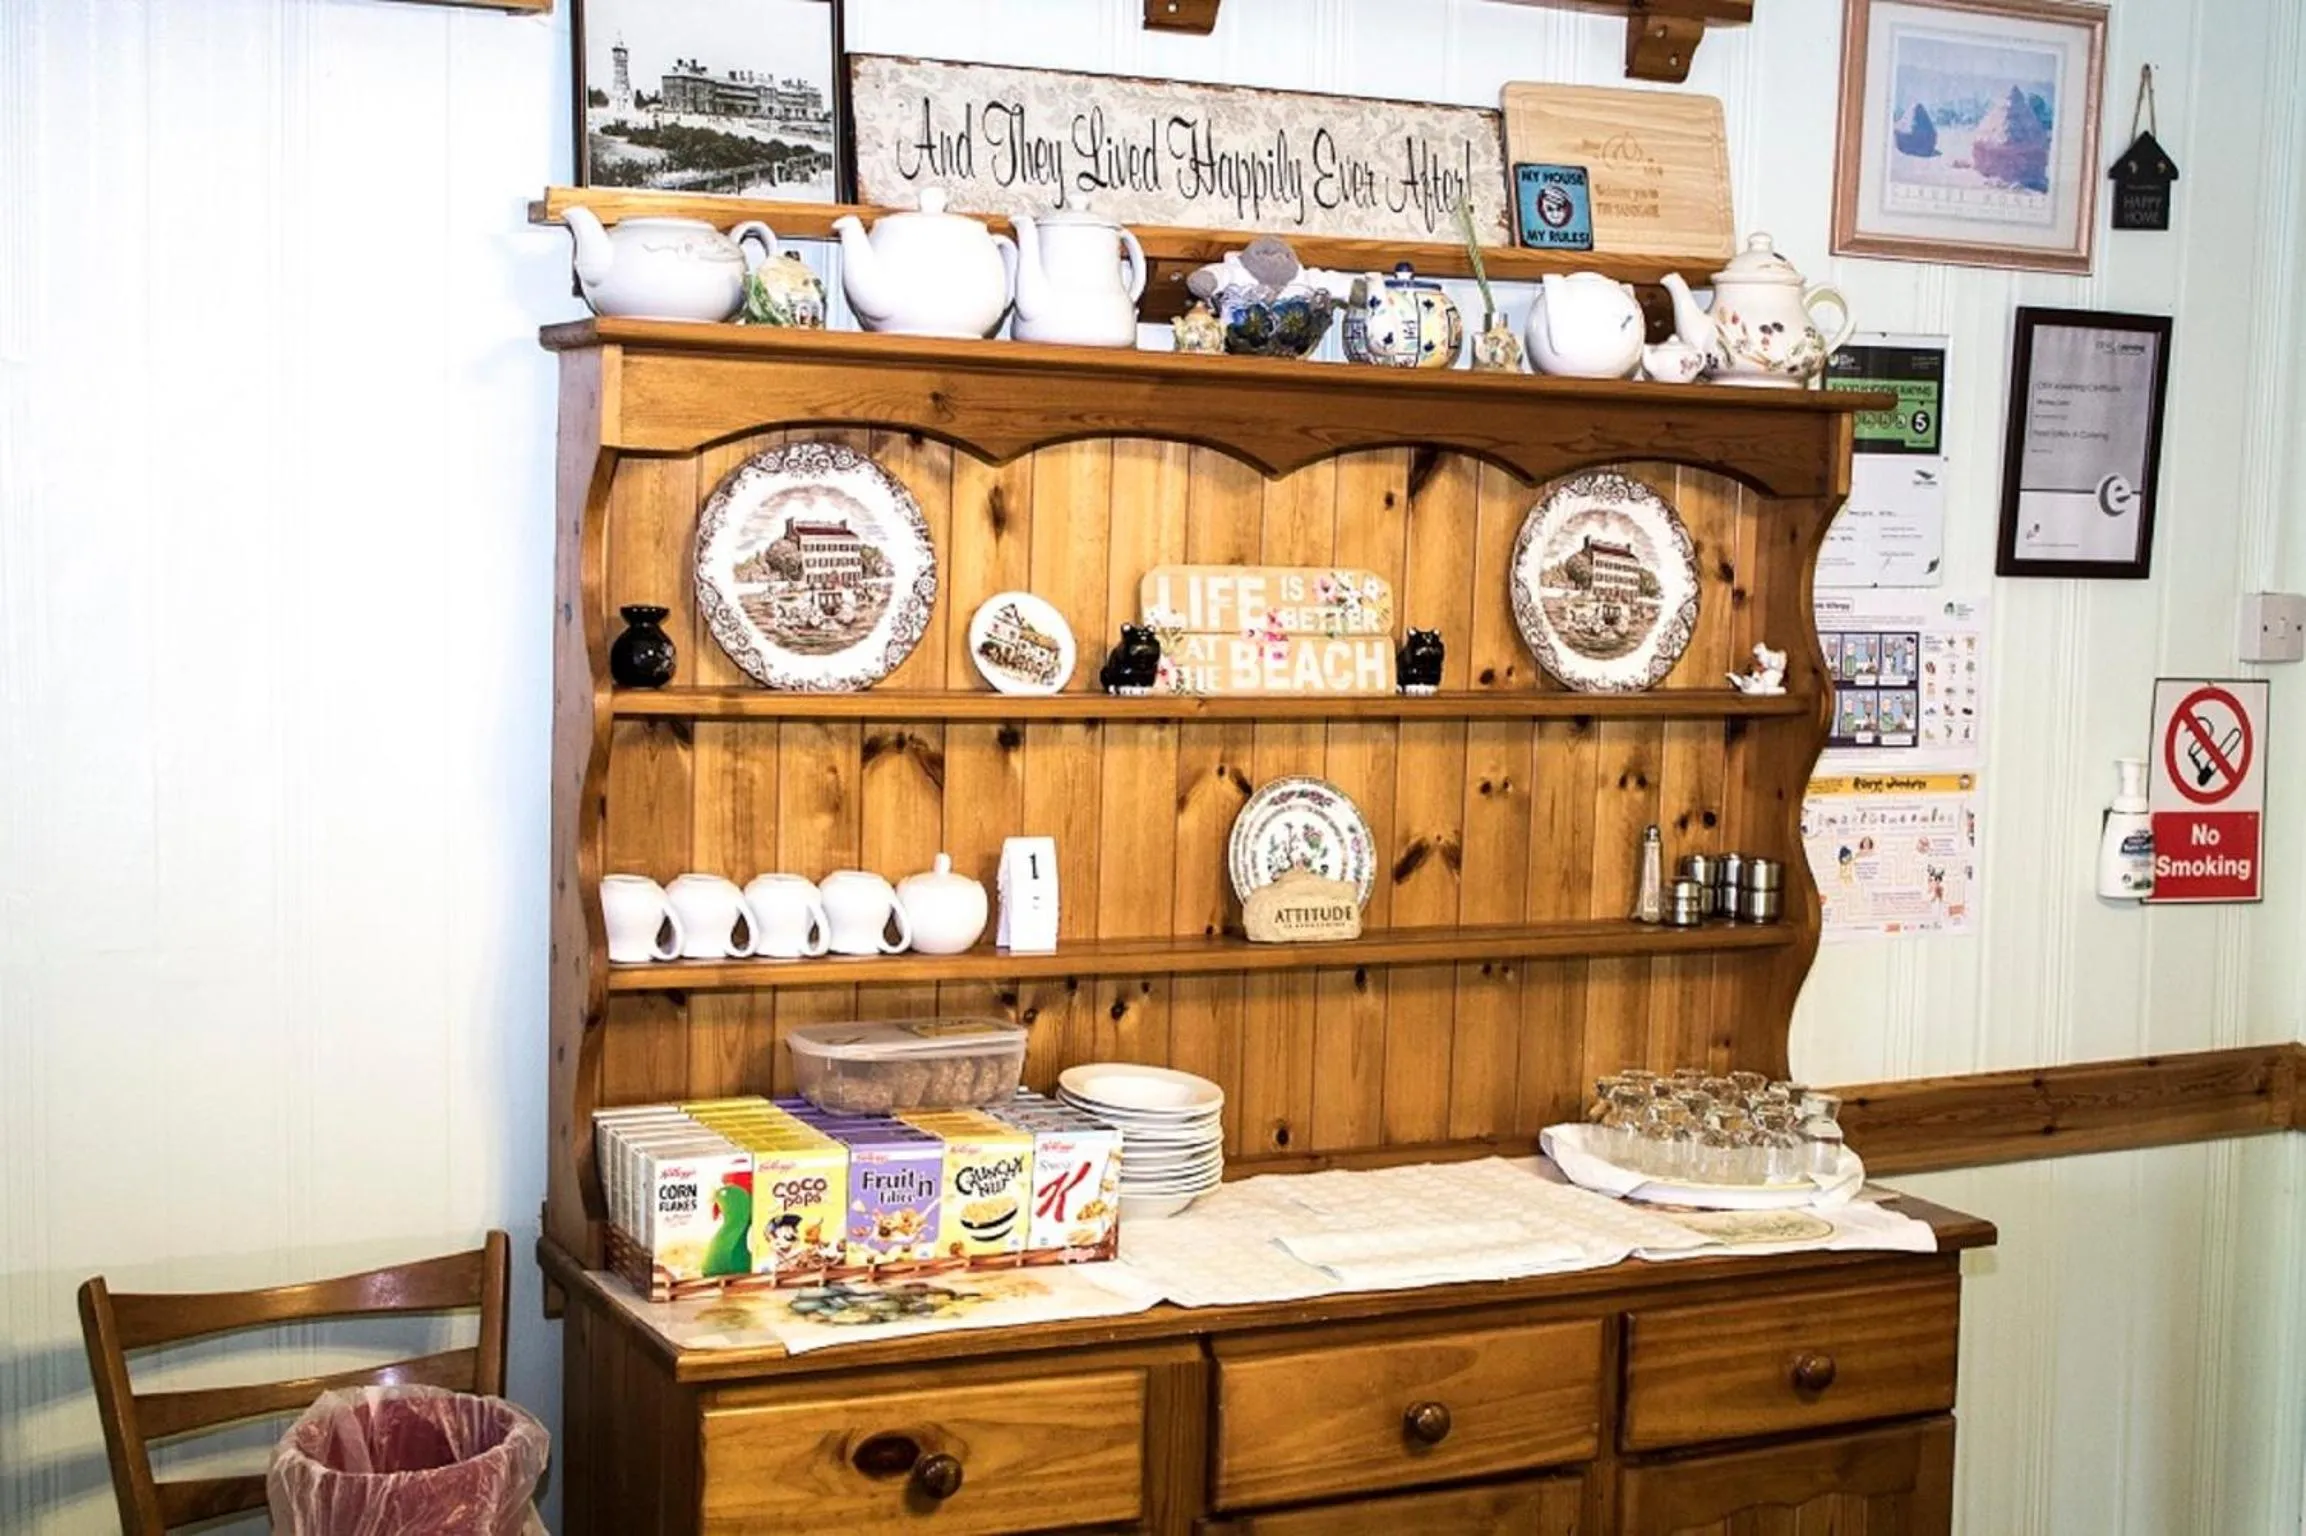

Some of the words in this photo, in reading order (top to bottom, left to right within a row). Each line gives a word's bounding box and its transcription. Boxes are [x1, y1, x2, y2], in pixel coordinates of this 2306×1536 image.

[897, 97, 975, 180] And
[982, 101, 1065, 209] They
[1072, 105, 1161, 192] Lived
[1167, 117, 1304, 226] Happily
[1312, 128, 1378, 209] Ever
[1386, 136, 1475, 234] After!
[1522, 170, 1540, 183] MY
[1543, 171, 1586, 186] HOUSE
[1526, 231, 1546, 242] MY
[1155, 575, 1267, 630] LIFE
[1280, 575, 1304, 602] IS
[1186, 635, 1217, 662] AT
[1229, 640, 1388, 691] BEACH
[2191, 823, 2221, 846] No
[1028, 852, 1040, 880] 1
[2155, 854, 2251, 881] Smoking
[1274, 905, 1352, 923] ATTITUDE
[772, 1178, 828, 1198] COCO
[862, 1168, 914, 1190] Fruit
[955, 1156, 1026, 1195] CRUNCHY
[658, 1183, 698, 1200] CORN
[1036, 1161, 1092, 1223] K
[658, 1200, 698, 1213] FLAKES
